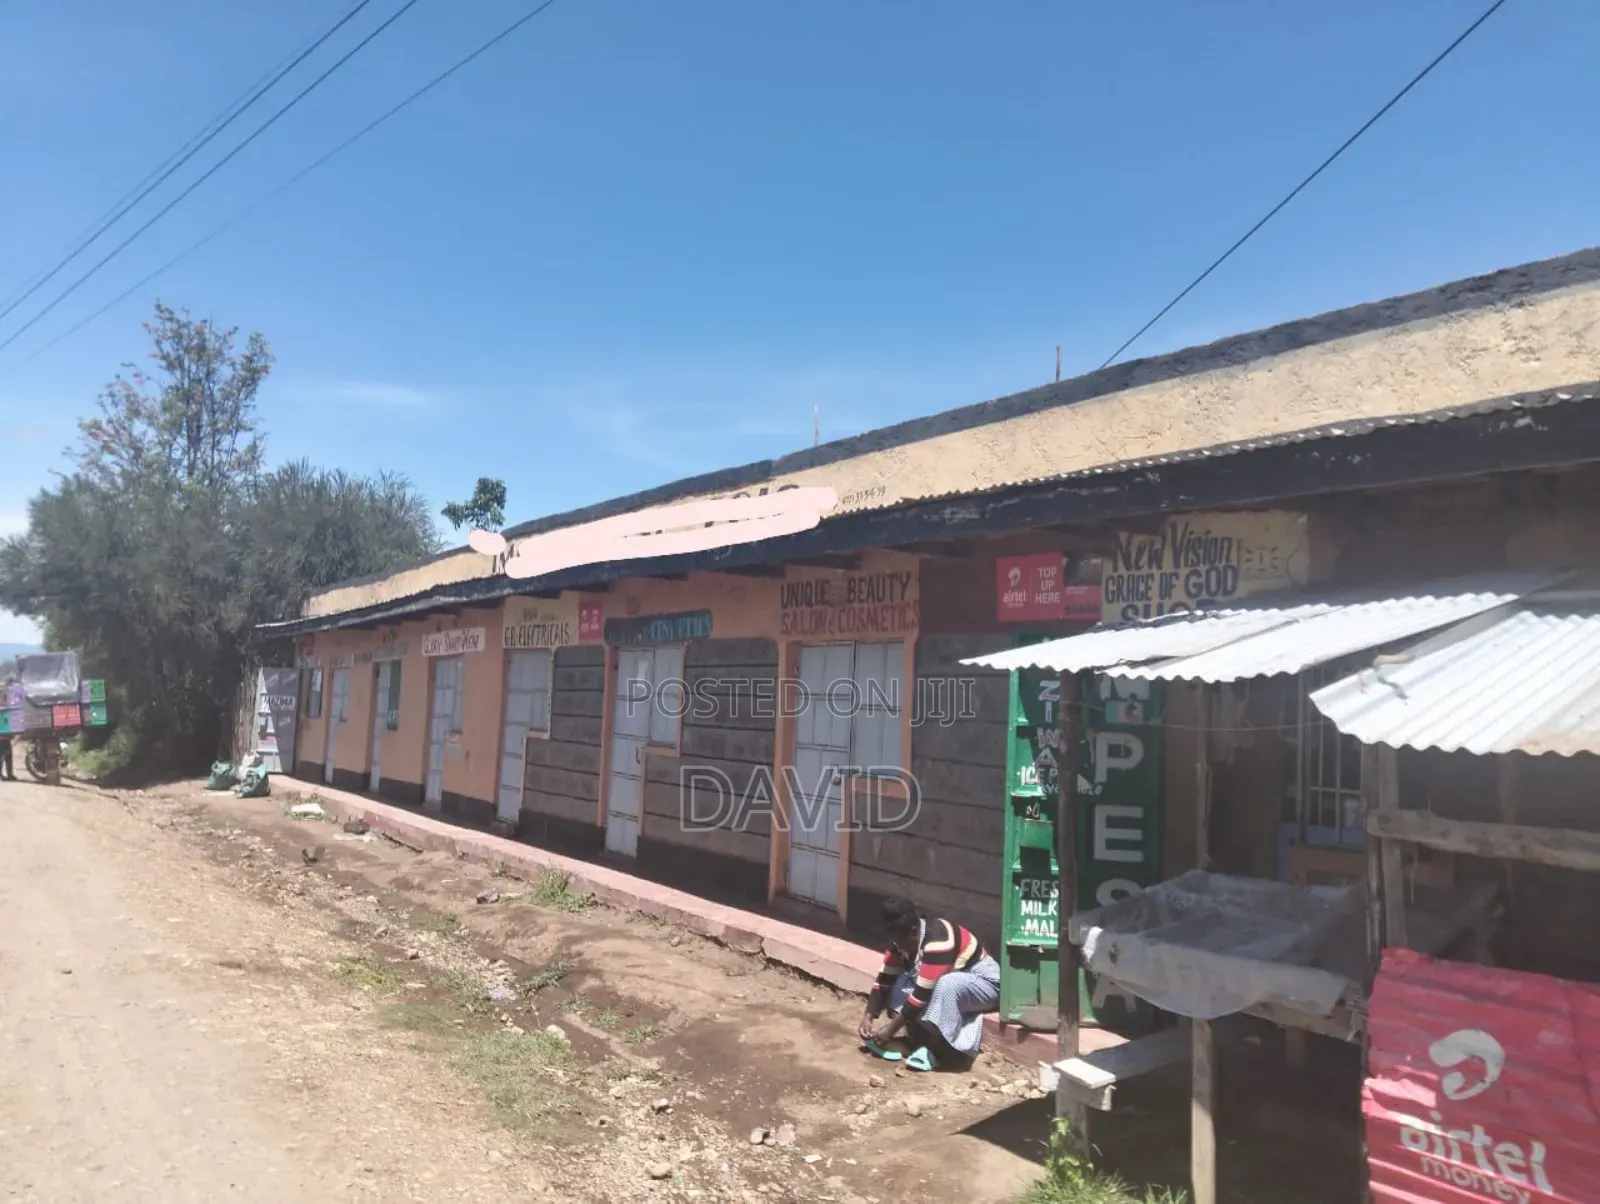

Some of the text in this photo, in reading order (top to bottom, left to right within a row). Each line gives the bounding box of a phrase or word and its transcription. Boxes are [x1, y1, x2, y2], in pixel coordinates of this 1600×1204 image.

[1169, 521, 1233, 569] Vision
[1037, 566, 1057, 578] TOP
[848, 570, 911, 604] BEAUTY
[1040, 580, 1056, 591] UP
[1104, 564, 1238, 604] GRACE OF GOD
[1003, 590, 1027, 602] airtel
[1036, 592, 1060, 604] HERE
[1020, 878, 1060, 898] FRES
[1021, 899, 1057, 916] MILK
[1025, 918, 1059, 938] MAL
[1400, 1110, 1553, 1196] airtel
[1420, 1155, 1531, 1204] money
